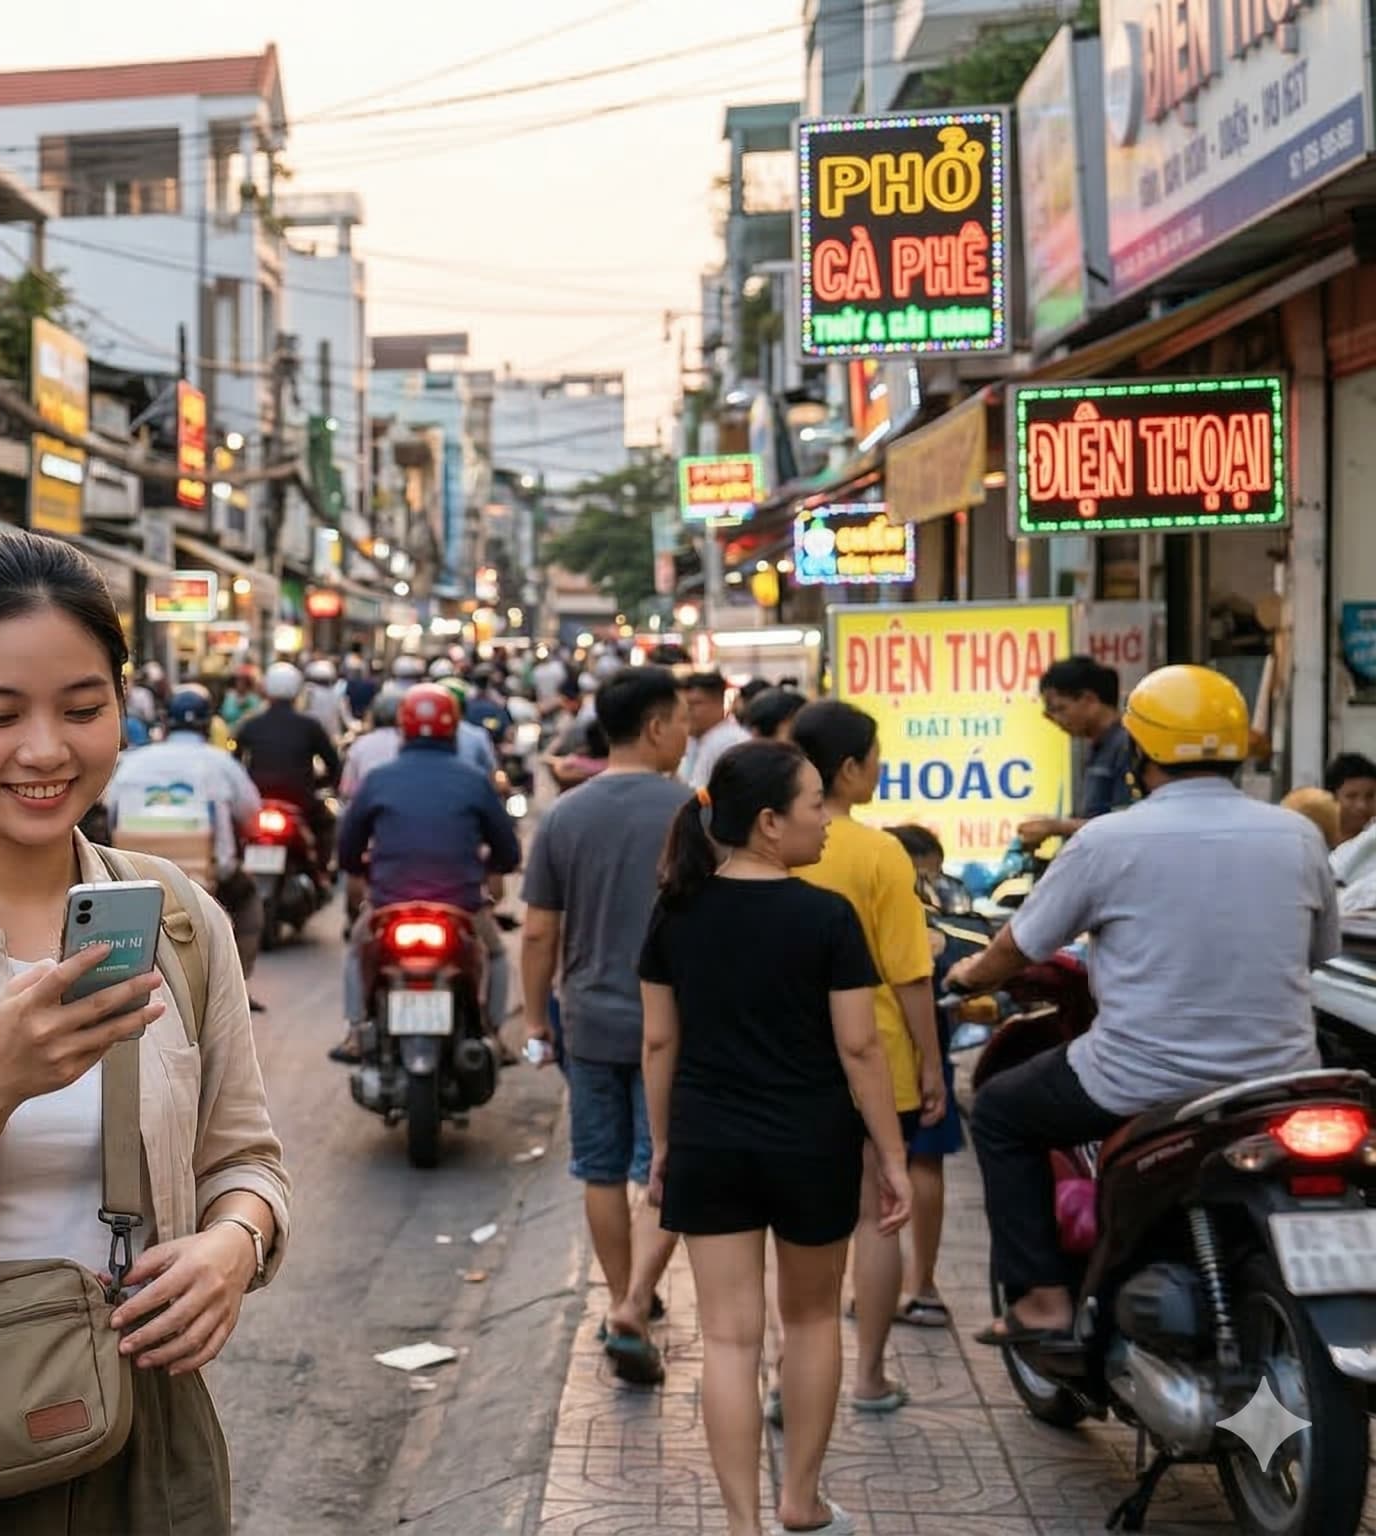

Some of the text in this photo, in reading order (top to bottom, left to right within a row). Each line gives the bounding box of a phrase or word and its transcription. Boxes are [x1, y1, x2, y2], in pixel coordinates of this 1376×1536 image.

[819, 126, 985, 218] PHỞ
[813, 220, 990, 302] CÀ PHÊ
[1028, 401, 1134, 518] ĐIỆN
[847, 618, 933, 708] ĐIỆN
